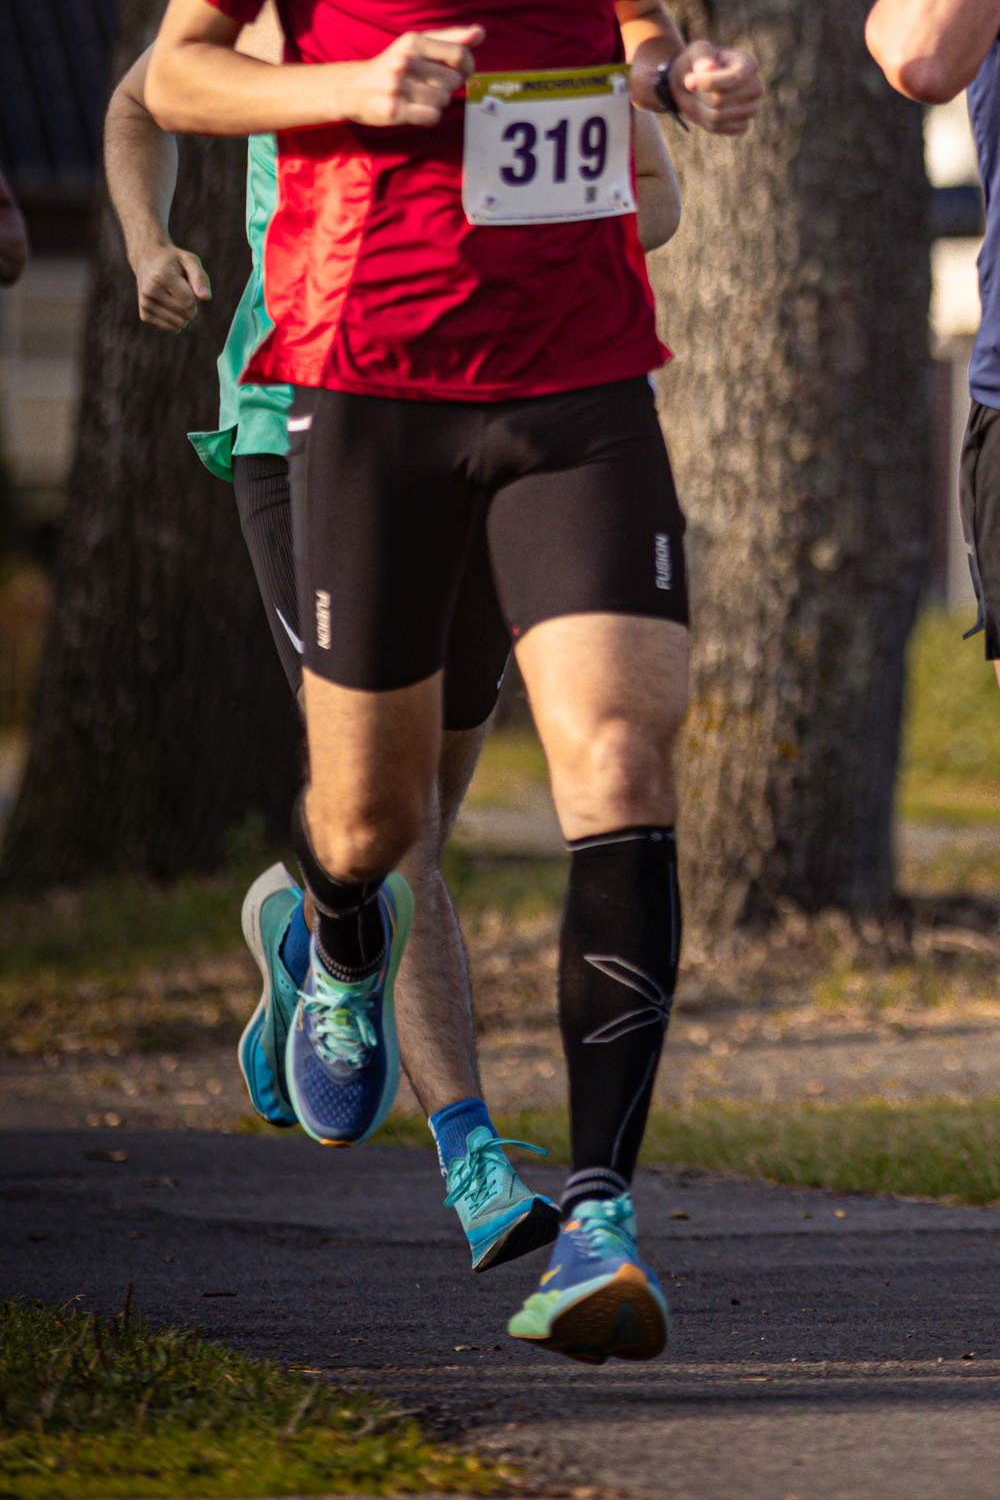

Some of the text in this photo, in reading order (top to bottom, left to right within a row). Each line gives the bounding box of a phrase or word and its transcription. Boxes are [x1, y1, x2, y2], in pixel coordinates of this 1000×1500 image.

[500, 116, 608, 187] 319
[655, 533, 671, 589] FUSION
[315, 590, 331, 649] FUSION
